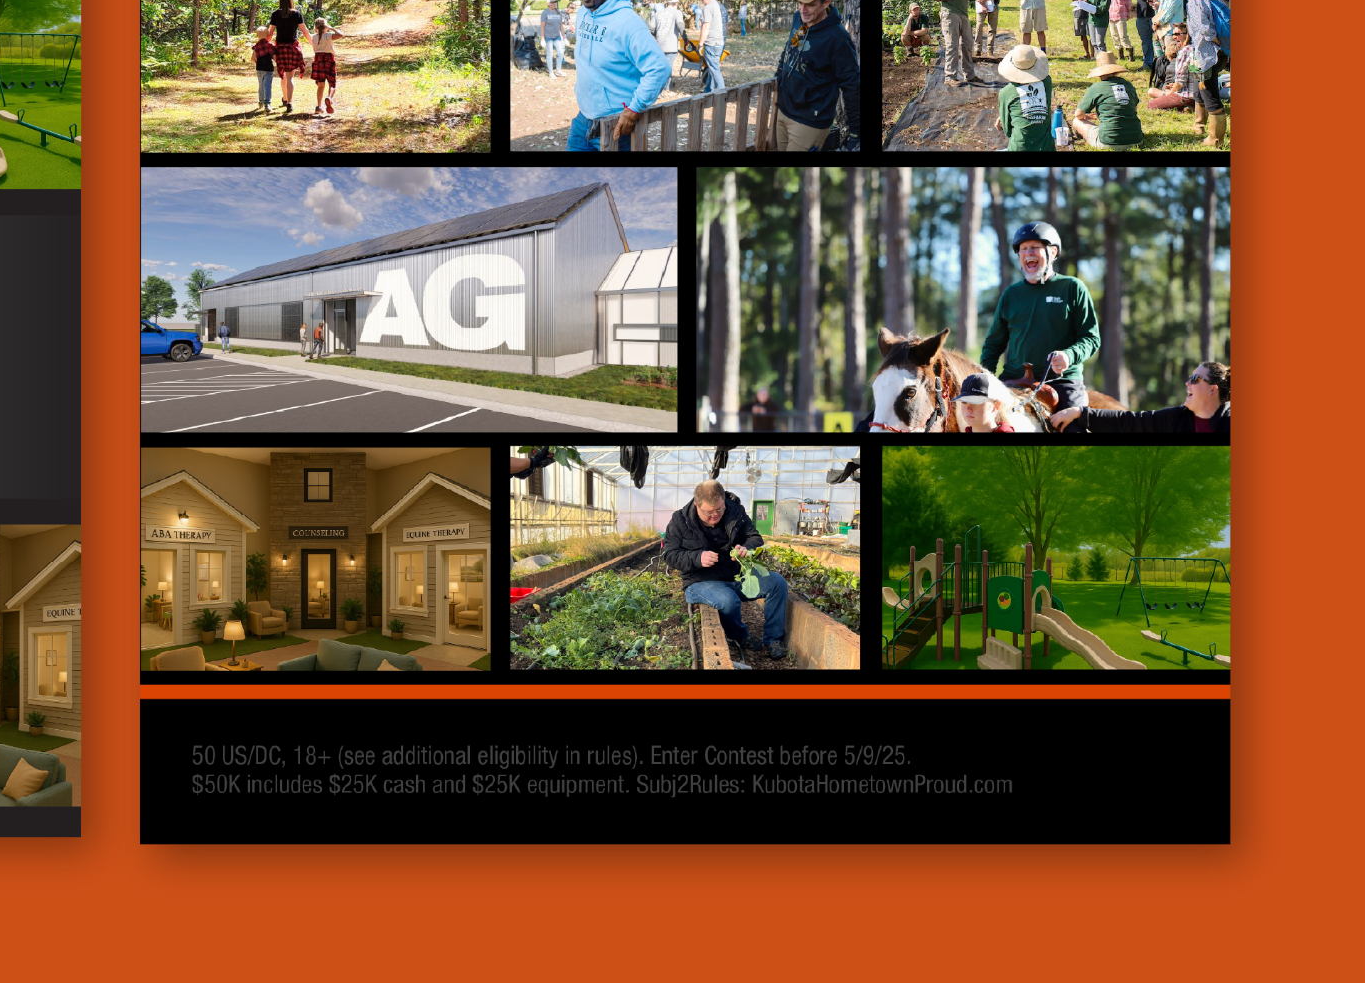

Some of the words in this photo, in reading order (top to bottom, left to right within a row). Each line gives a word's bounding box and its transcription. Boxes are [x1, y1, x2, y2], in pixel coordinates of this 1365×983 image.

[359, 253, 526, 352] AG
[151, 529, 172, 538] ABA
[174, 530, 212, 540] THERAPY
[292, 529, 345, 537] COUNSELING
[406, 530, 431, 539] EQUINE
[433, 528, 466, 537] THERAPY
[46, 608, 76, 618] EQUINE
[192, 745, 216, 766] 50
[222, 745, 286, 768] US/DC,
[293, 745, 331, 766] 18+
[338, 745, 376, 770] (see
[381, 745, 471, 766] additional
[477, 745, 559, 770] eligibility
[565, 745, 581, 765] in
[587, 745, 644, 770] rules).
[651, 745, 699, 766] Enter
[704, 745, 774, 766] Contest
[780, 745, 838, 766] before
[844, 745, 911, 766] 5/9/25.
[192, 773, 241, 796] $50K
[247, 774, 323, 794] includes
[328, 773, 378, 796] $25K
[383, 774, 426, 794] cash
[432, 774, 466, 794] and
[472, 773, 521, 796] $25K
[527, 774, 630, 798] equipment.
[636, 774, 745, 798] Subj2Rules:
[752, 774, 1013, 794] KubotaHometownProud.com
